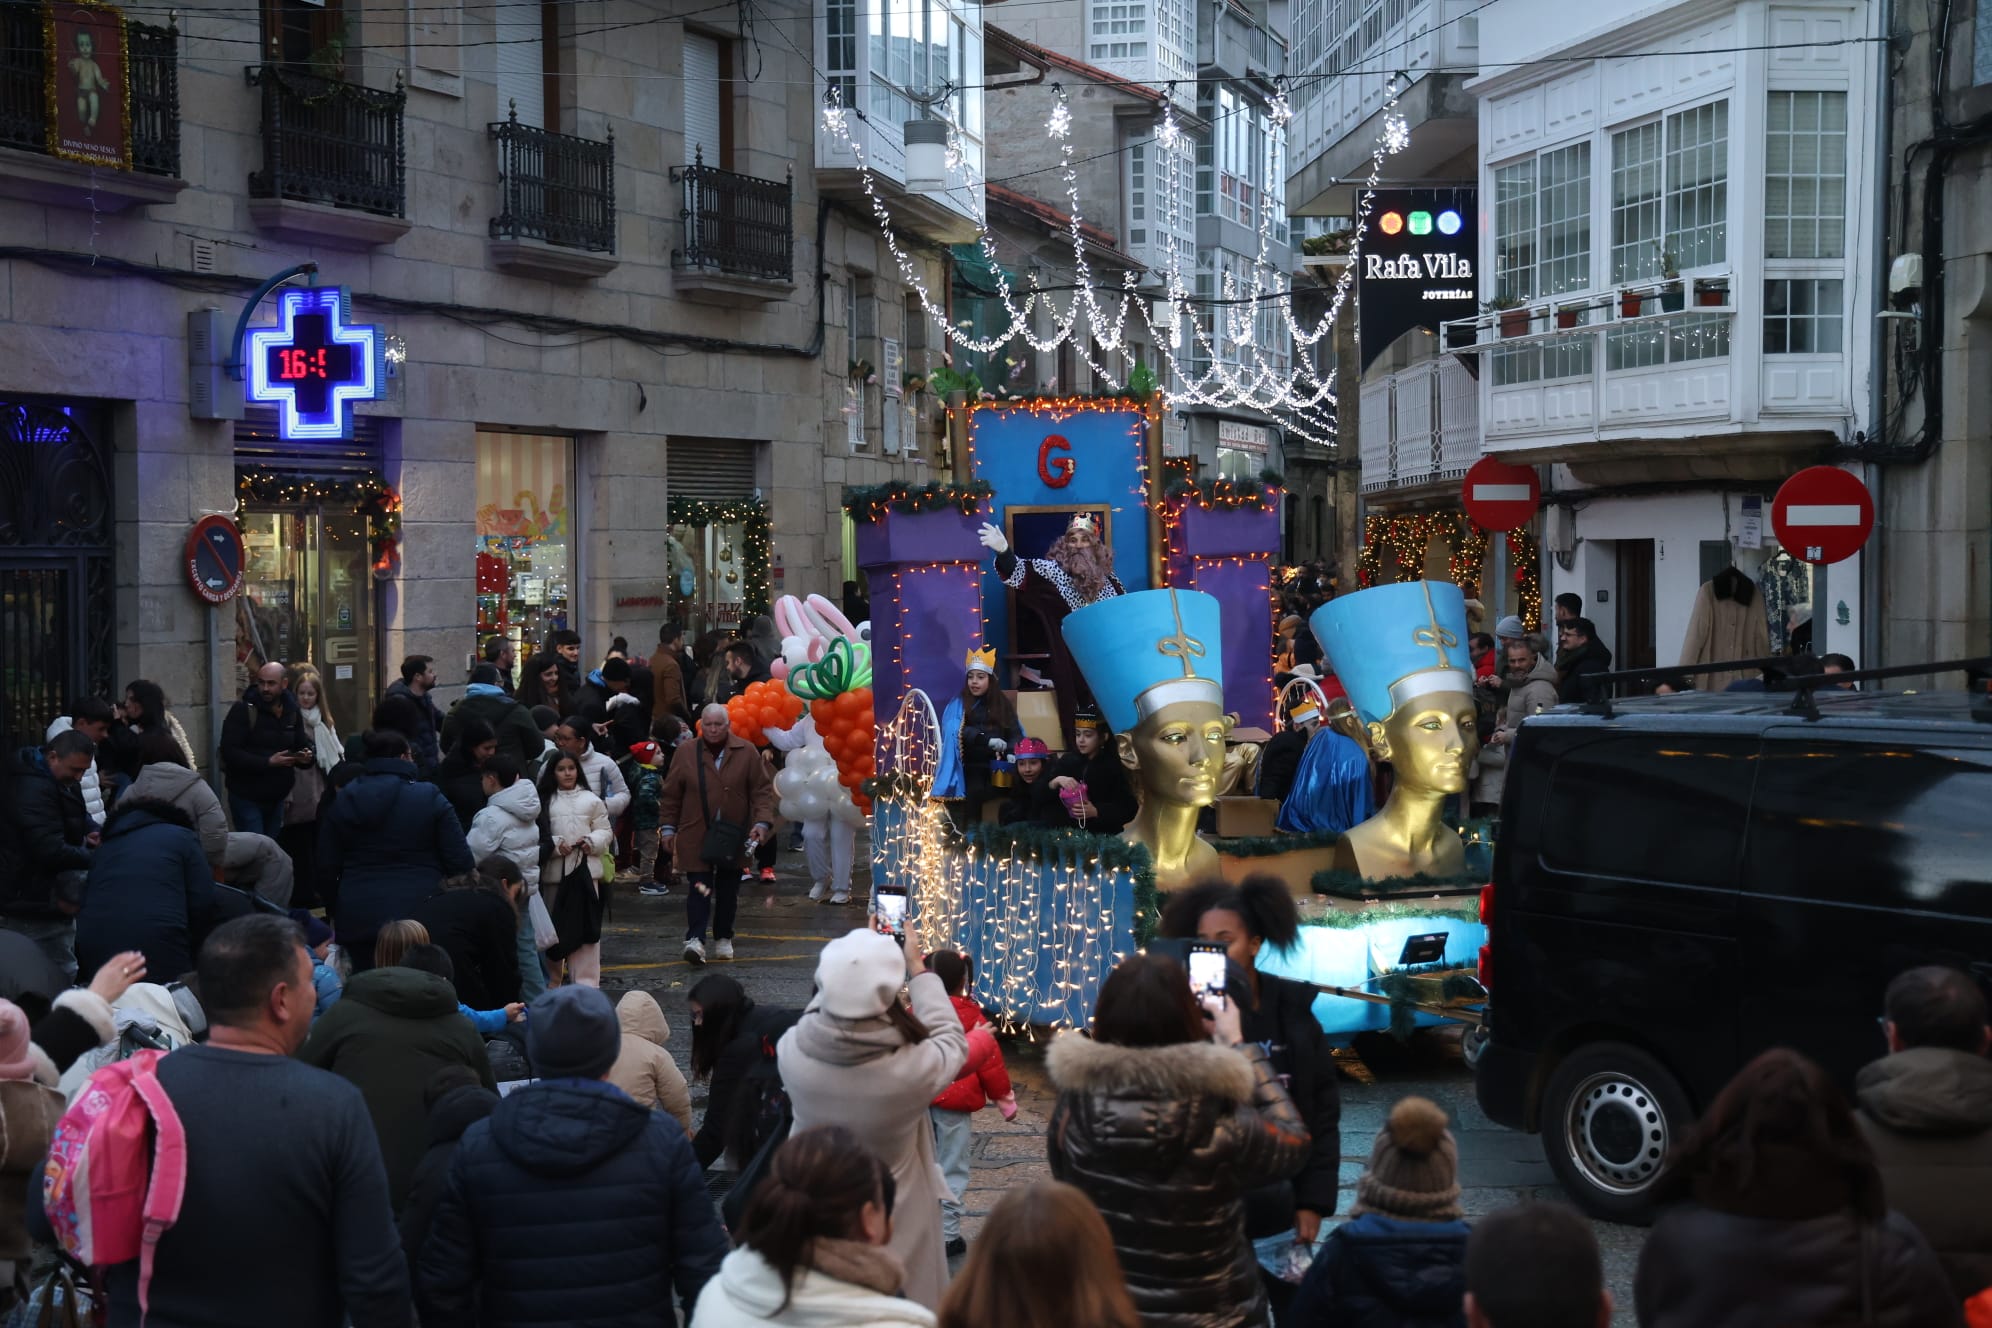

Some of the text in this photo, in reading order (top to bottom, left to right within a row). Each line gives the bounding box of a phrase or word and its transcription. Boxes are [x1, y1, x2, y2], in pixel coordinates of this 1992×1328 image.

[1365, 252, 1473, 279] Rafa Vila
[1422, 288, 1473, 300] JOYERÍAS
[1038, 434, 1075, 489] G
[190, 559, 204, 591] EXCEPTO
[202, 588, 219, 602] CARGA
[223, 570, 243, 601] DESCARGA
